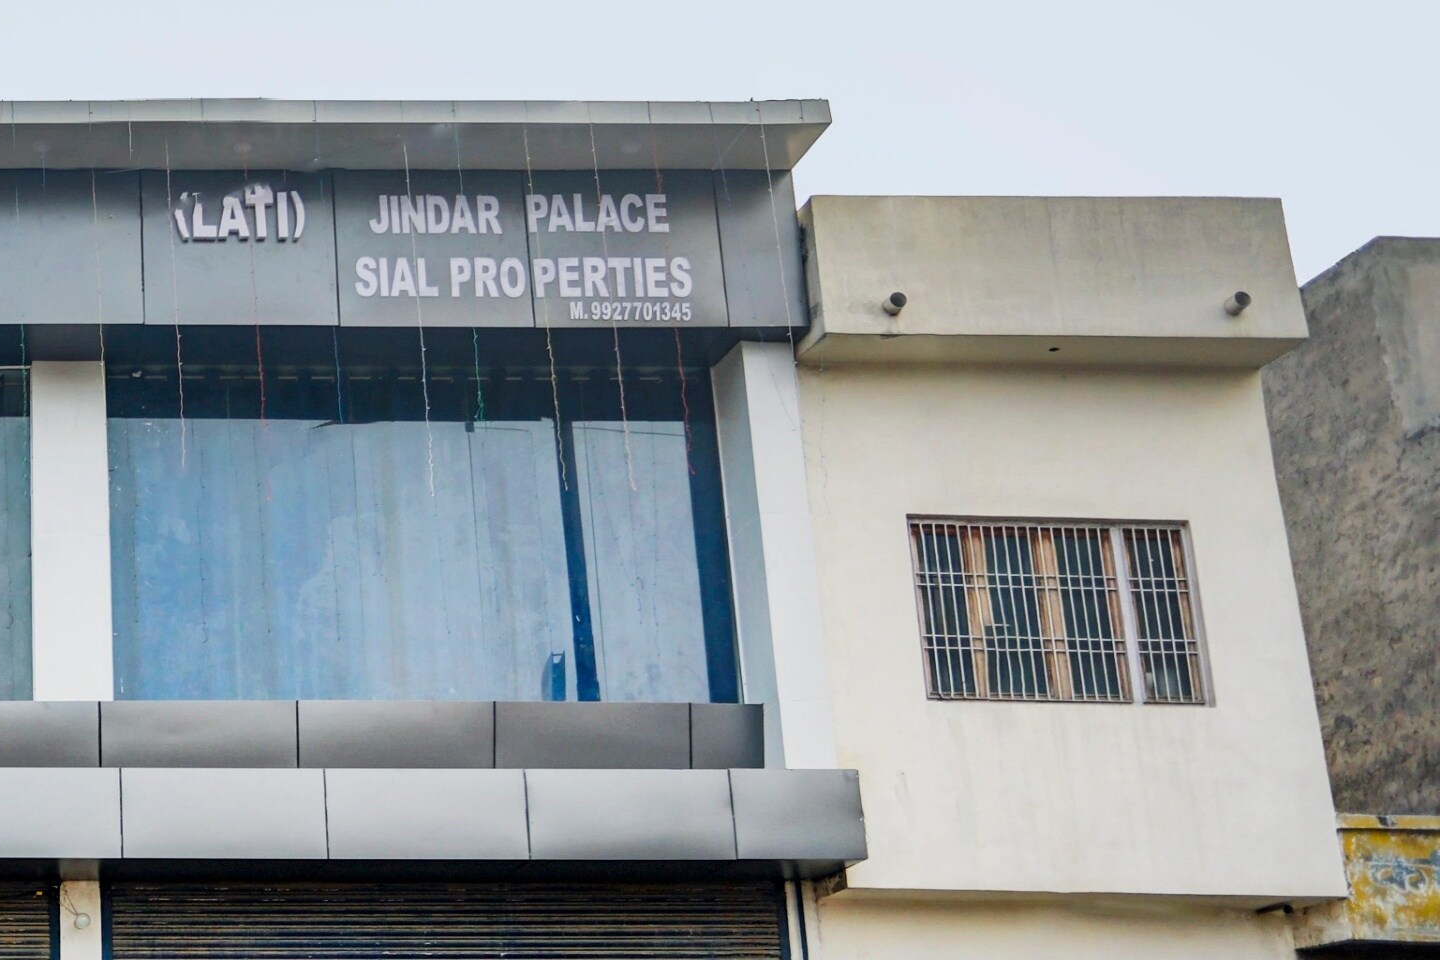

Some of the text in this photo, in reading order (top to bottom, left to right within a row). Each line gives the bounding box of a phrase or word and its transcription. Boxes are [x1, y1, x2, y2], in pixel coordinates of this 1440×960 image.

[369, 193, 670, 234] JINDAR PALACE
[355, 256, 692, 297] SIAL PROPERTIES
